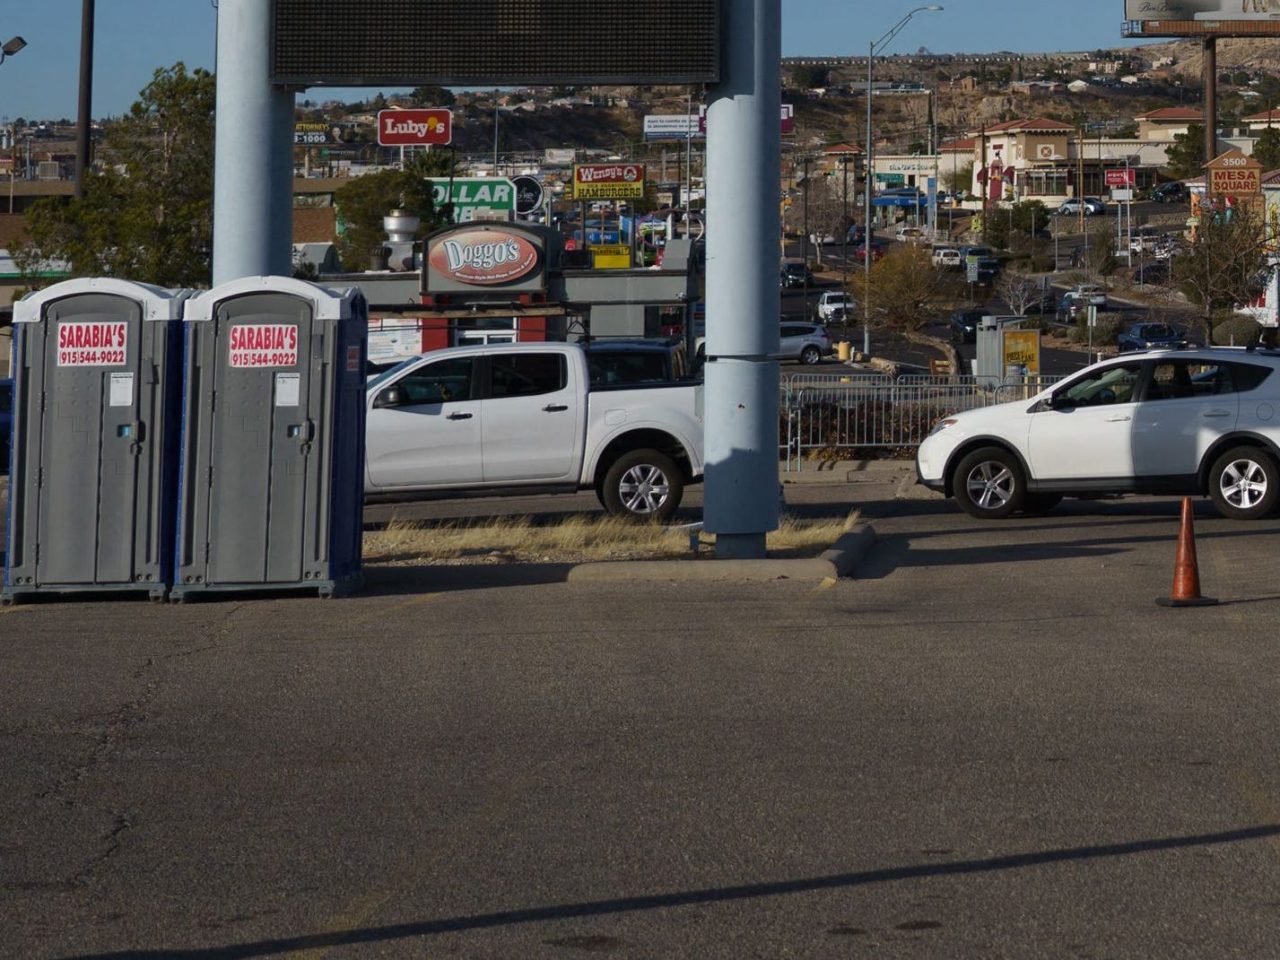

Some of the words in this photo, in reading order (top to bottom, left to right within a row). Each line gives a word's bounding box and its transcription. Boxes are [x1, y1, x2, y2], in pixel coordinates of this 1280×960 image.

[385, 117, 445, 138] Luby's
[1222, 157, 1247, 166] 3500
[1214, 171, 1256, 180] MESA
[578, 188, 641, 198] HAMBURGERS
[1214, 180, 1257, 191] SQUARE
[432, 185, 511, 203] OLLAR
[444, 238, 520, 273] Doggo's
[60, 324, 125, 349] SARABIA'S
[231, 326, 297, 350] SARABIA'S
[60, 350, 124, 365] (915)544-9022
